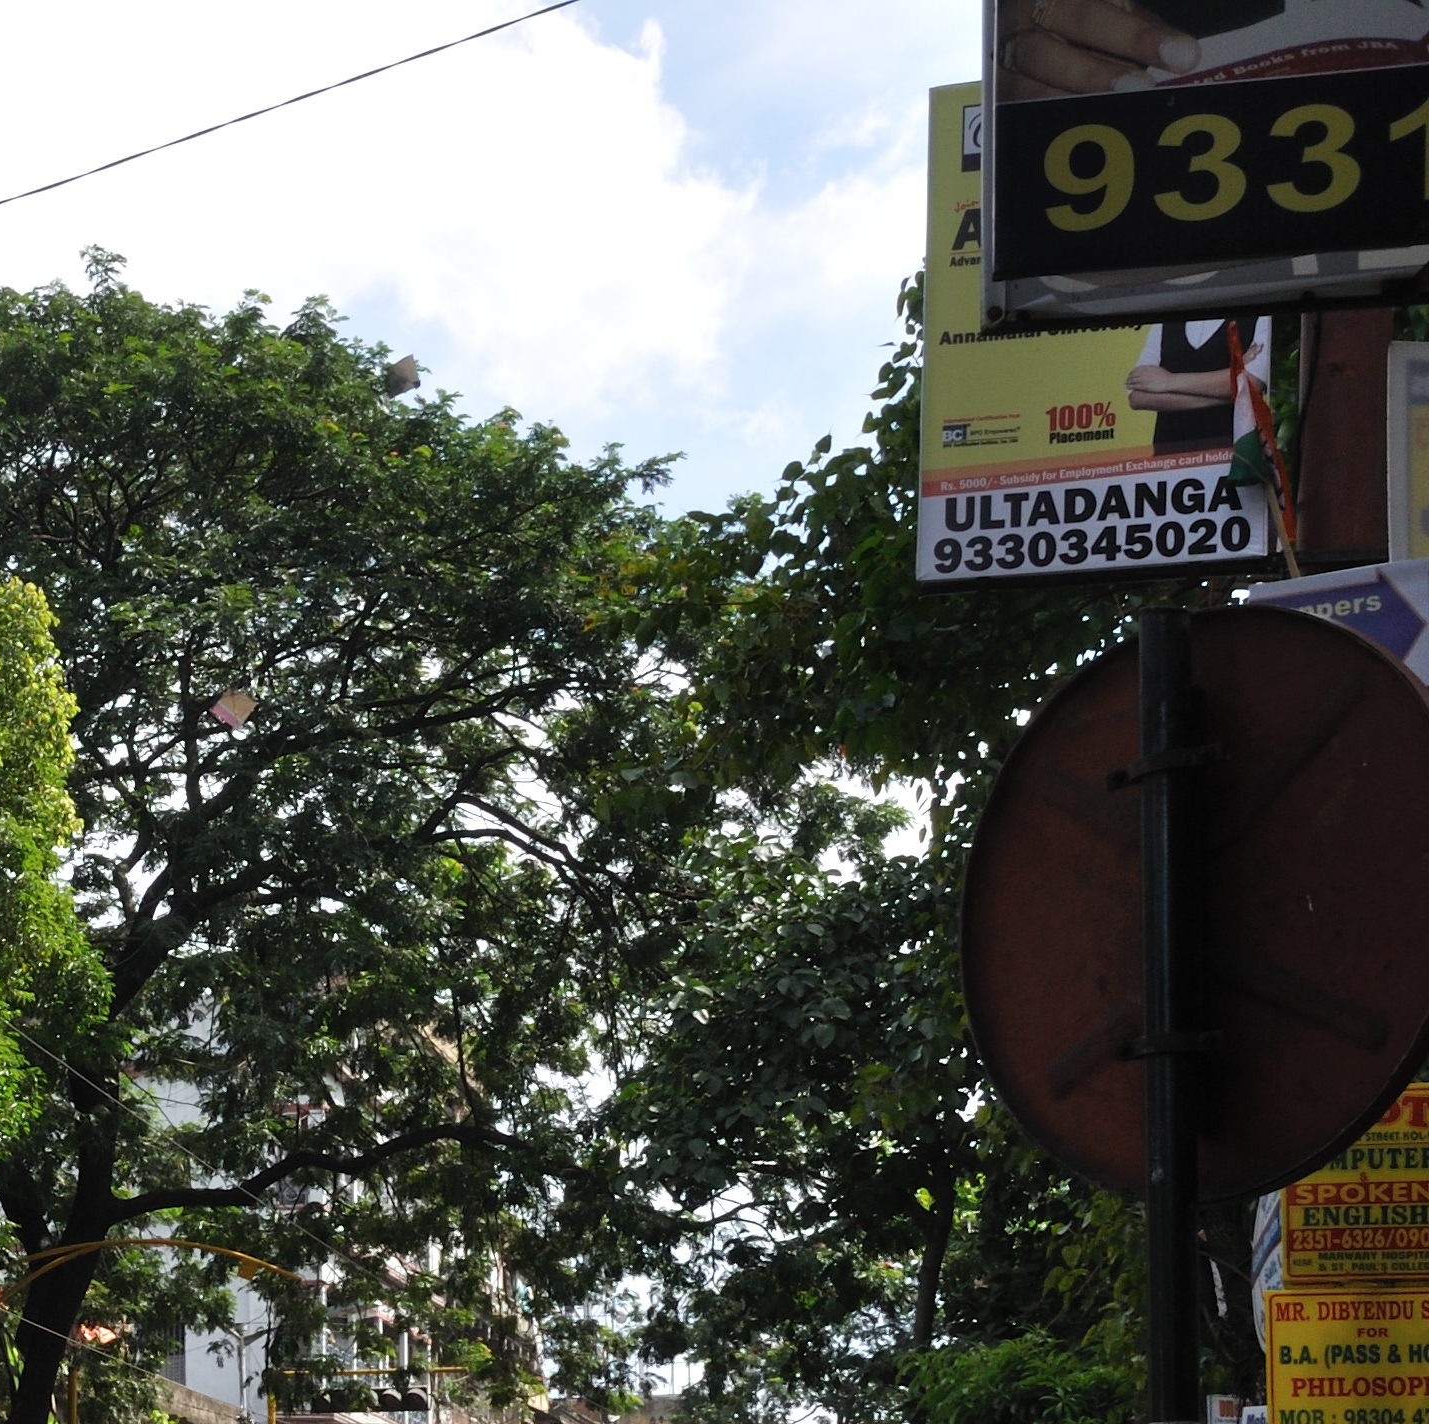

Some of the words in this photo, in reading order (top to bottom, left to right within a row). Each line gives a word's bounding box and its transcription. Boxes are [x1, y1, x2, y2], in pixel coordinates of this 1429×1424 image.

[1232, 52, 1295, 76] Books
[1301, 43, 1349, 57] from
[1045, 401, 1116, 431] 100%
[1049, 427, 1115, 444] Placement
[1000, 472, 1040, 488] Subsidy
[1042, 470, 1057, 480] for
[1059, 463, 1124, 481] Employment
[1126, 457, 1176, 472] Exchange
[1178, 453, 1203, 465] card
[945, 476, 1242, 532] ULTADANGA
[934, 516, 1251, 573] 9330345020
[1366, 1131, 1400, 1142] STREET
[1295, 1182, 1429, 1204] SPOKEN
[1302, 1205, 1429, 1227] ENGLISH
[1318, 1250, 1378, 1261] MARWARY
[1352, 1260, 1388, 1271] PAUL'S
[1275, 1302, 1310, 1322] MR.
[1317, 1300, 1415, 1321] DIBYENDU
[1357, 1327, 1390, 1338] FOR
[1279, 1345, 1318, 1365] B.A.
[1324, 1344, 1381, 1370] (PASS
